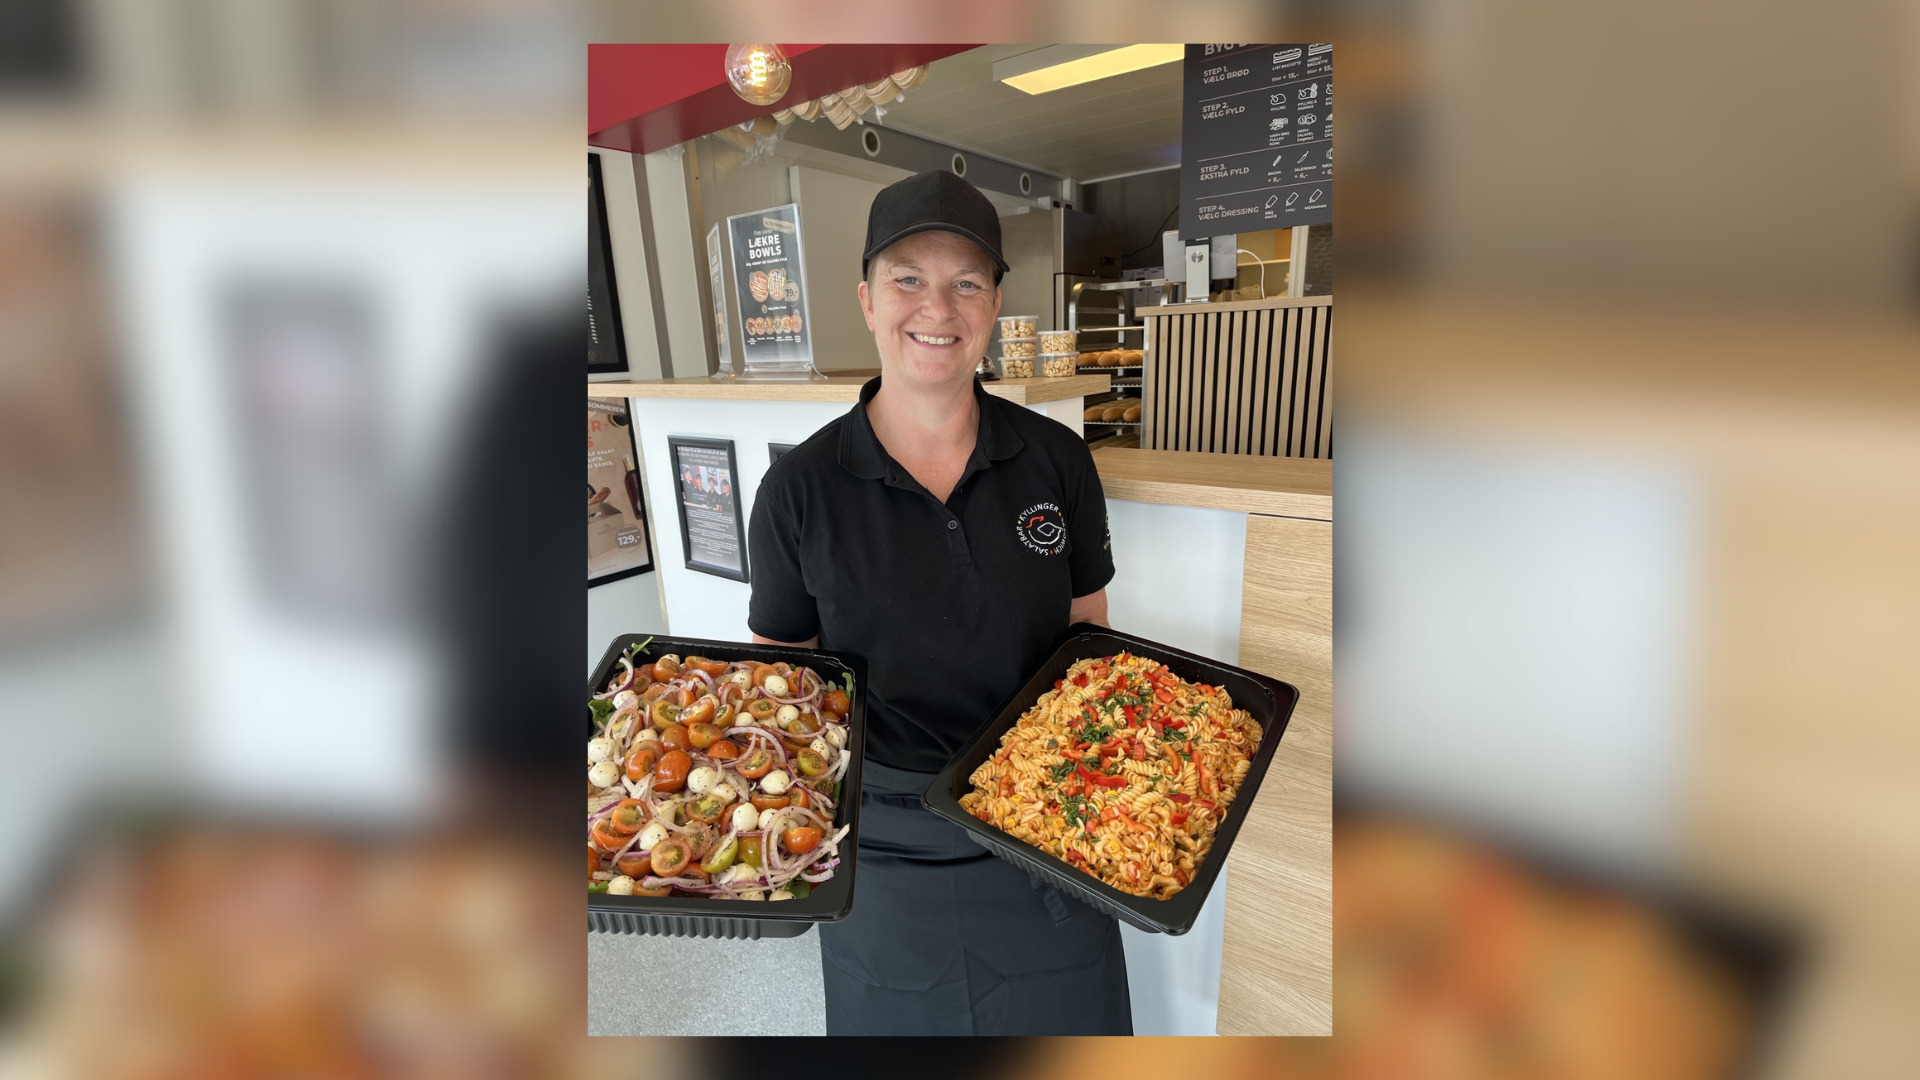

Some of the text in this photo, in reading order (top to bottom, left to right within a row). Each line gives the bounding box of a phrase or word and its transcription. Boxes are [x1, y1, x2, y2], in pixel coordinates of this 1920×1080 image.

[1307, 59, 1328, 67] BAGUETTE
[1203, 67, 1222, 77] STEP
[1203, 69, 1250, 84] VÆLG BRØD
[1202, 104, 1221, 113] STEP
[1202, 106, 1246, 120] VÆLG FYLD
[1200, 164, 1219, 174] STEP
[1200, 167, 1250, 181] EKSTRA FYLD
[1198, 206, 1259, 221] VÆLG DRESSING
[1199, 205, 1217, 214] STEP
[748, 234, 780, 249] LÆKRE
[749, 245, 782, 260] BOWLS
[588, 402, 625, 413] SOMMEREN
[1019, 502, 1059, 522] KYLLINGER
[618, 535, 641, 546] 129,-
[1016, 526, 1049, 556] SALATBAR
